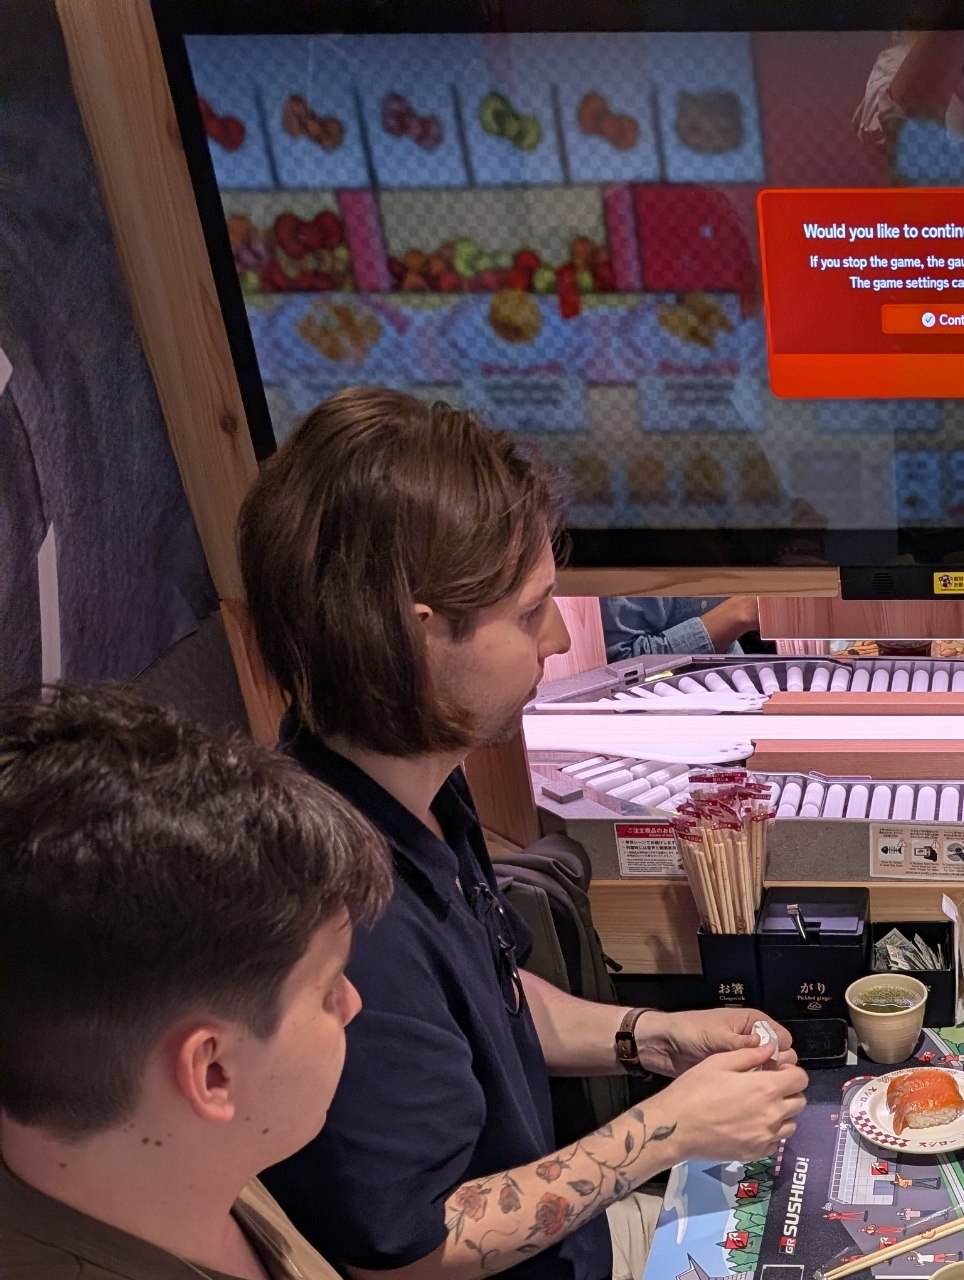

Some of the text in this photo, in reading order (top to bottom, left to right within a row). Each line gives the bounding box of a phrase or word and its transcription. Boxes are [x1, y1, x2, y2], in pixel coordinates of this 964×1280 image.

[803, 223, 845, 238] Would
[849, 226, 873, 242] you
[877, 223, 900, 238] like
[903, 224, 918, 238] to
[810, 255, 818, 267] If
[821, 258, 840, 270] you
[843, 256, 867, 270] stop
[870, 255, 888, 267] the
[890, 258, 924, 270] game,
[927, 255, 944, 267] the
[849, 276, 870, 288] The
[873, 279, 903, 291] game
[905, 276, 949, 291] settings
[718, 983, 744, 995] お箸
[800, 983, 827, 995] がり
[918, 1138, 957, 1148] スシロー
[783, 1156, 810, 1255] GR SUSHIGO!
